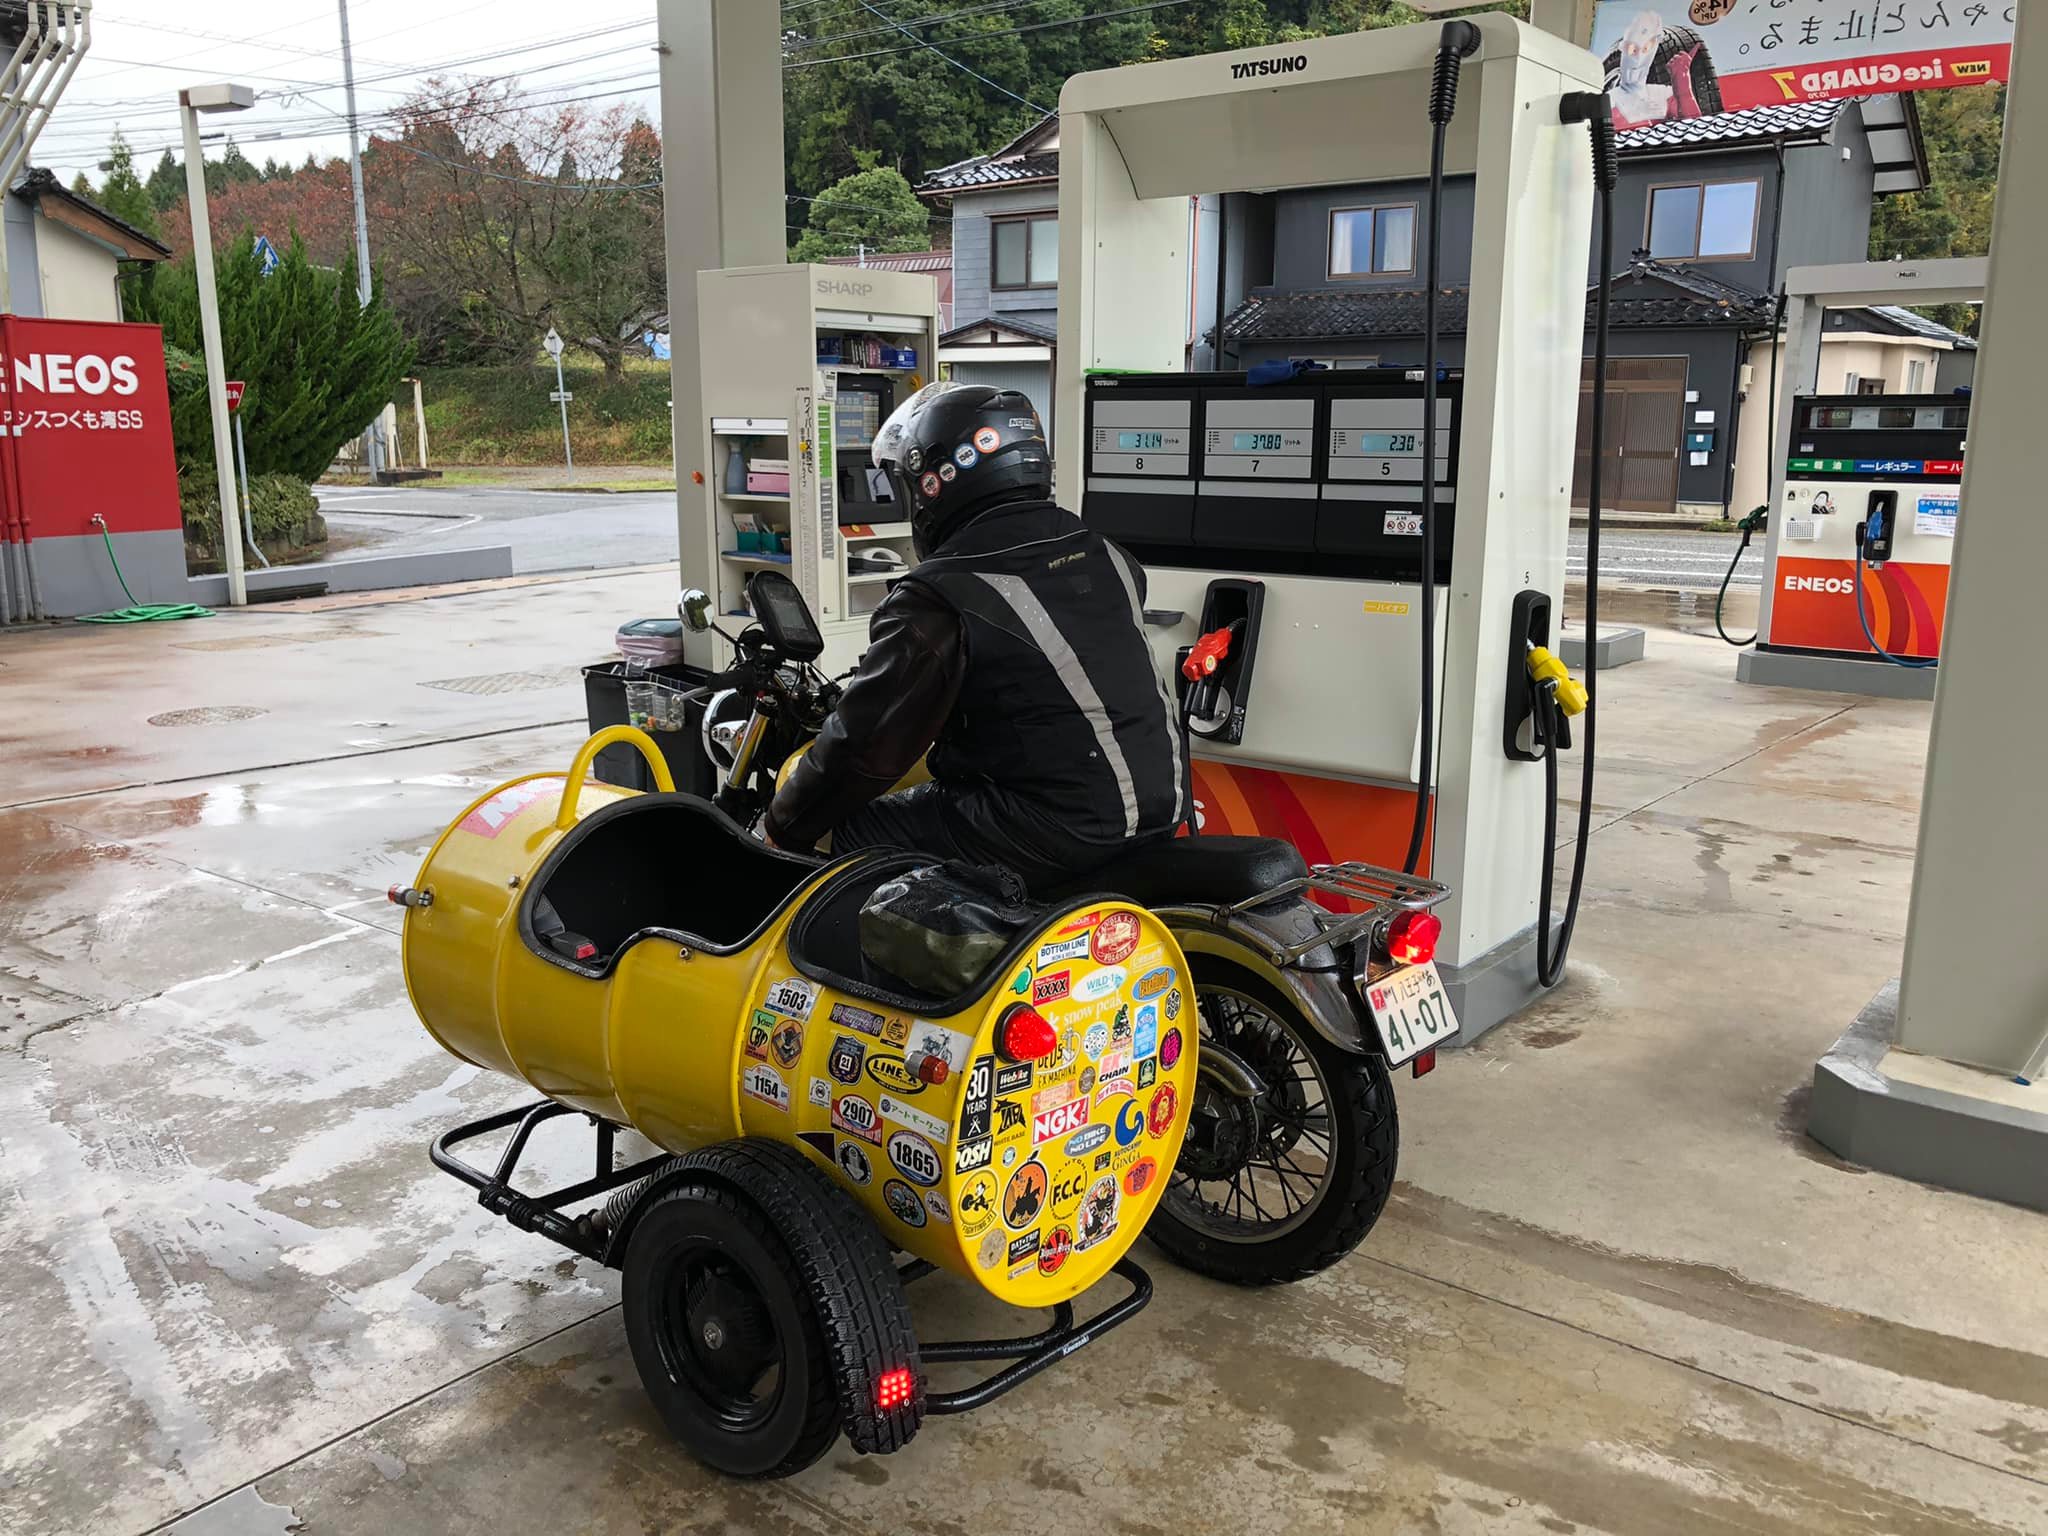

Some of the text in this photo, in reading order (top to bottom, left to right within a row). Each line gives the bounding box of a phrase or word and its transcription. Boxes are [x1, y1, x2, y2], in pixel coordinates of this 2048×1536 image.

[1231, 55, 1307, 79] TATSUNO
[816, 280, 873, 296] SHARP
[0, 353, 139, 395] NEOS
[1389, 435, 1415, 451] 2.30
[1135, 457, 1144, 470] 8
[1251, 460, 1260, 473] 7
[1381, 462, 1391, 475] 5
[1524, 571, 1530, 585] 5
[1784, 575, 1854, 595] ENEOS
[1040, 942, 1071, 957] BOTTOM
[1071, 938, 1086, 950] LINE
[1036, 978, 1067, 999] XXXX
[1086, 974, 1114, 990] WILD-1
[777, 987, 808, 1011] 1503
[1064, 990, 1122, 1024] snow peak
[1388, 990, 1448, 1051] 41-07
[841, 1055, 850, 1069] 21
[1038, 1044, 1064, 1069] DEUS
[967, 1066, 989, 1101] 30
[1099, 1065, 1129, 1082] CHAIN
[754, 1075, 779, 1099] 1154
[842, 1099, 872, 1127] 2907
[966, 1099, 987, 1115] YEARS
[1033, 1102, 1081, 1144] NGK
[1069, 1125, 1107, 1146] NO BIKE
[1070, 1134, 1106, 1154] NO LIFE
[895, 1141, 934, 1178] 1865
